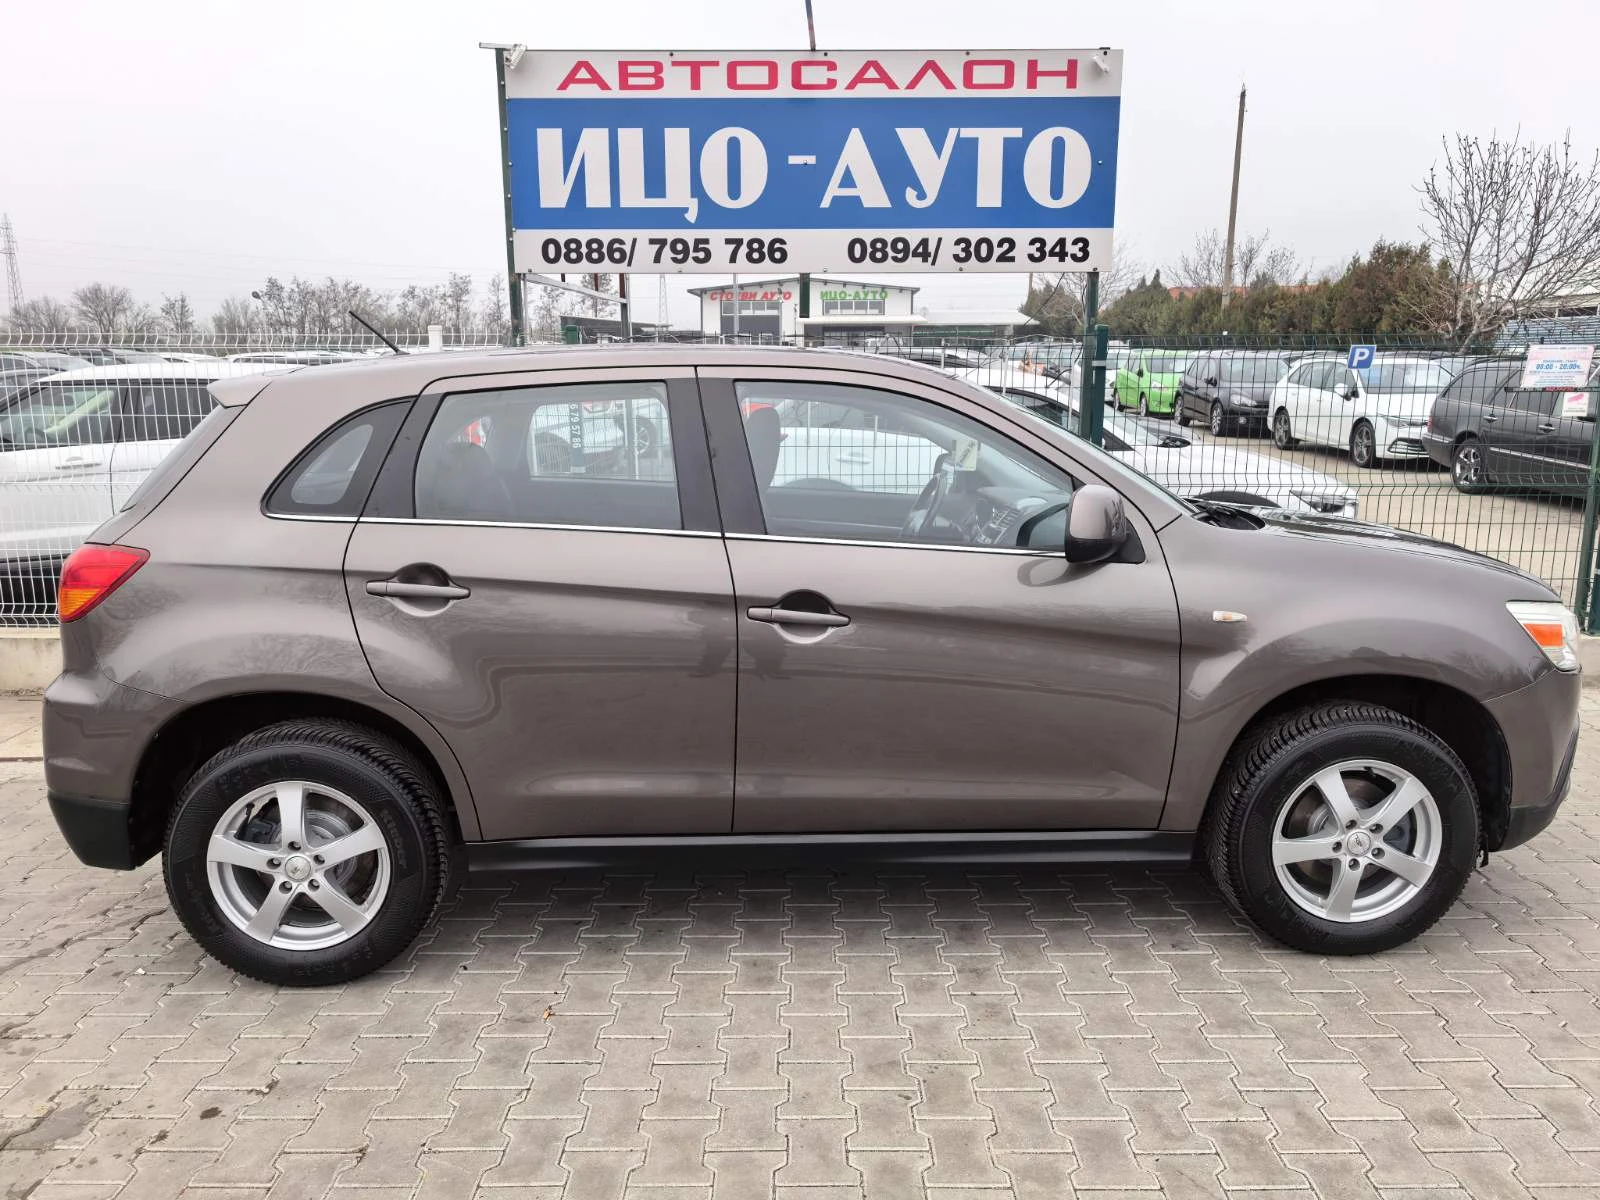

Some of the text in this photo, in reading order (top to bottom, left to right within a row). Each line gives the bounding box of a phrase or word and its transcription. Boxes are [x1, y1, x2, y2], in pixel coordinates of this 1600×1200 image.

[557, 59, 1079, 91] АВТОСАЛОН
[541, 237, 788, 267] 0886/ 795 786
[847, 237, 1090, 266] 0894/ 302 343
[1352, 348, 1370, 367] P
